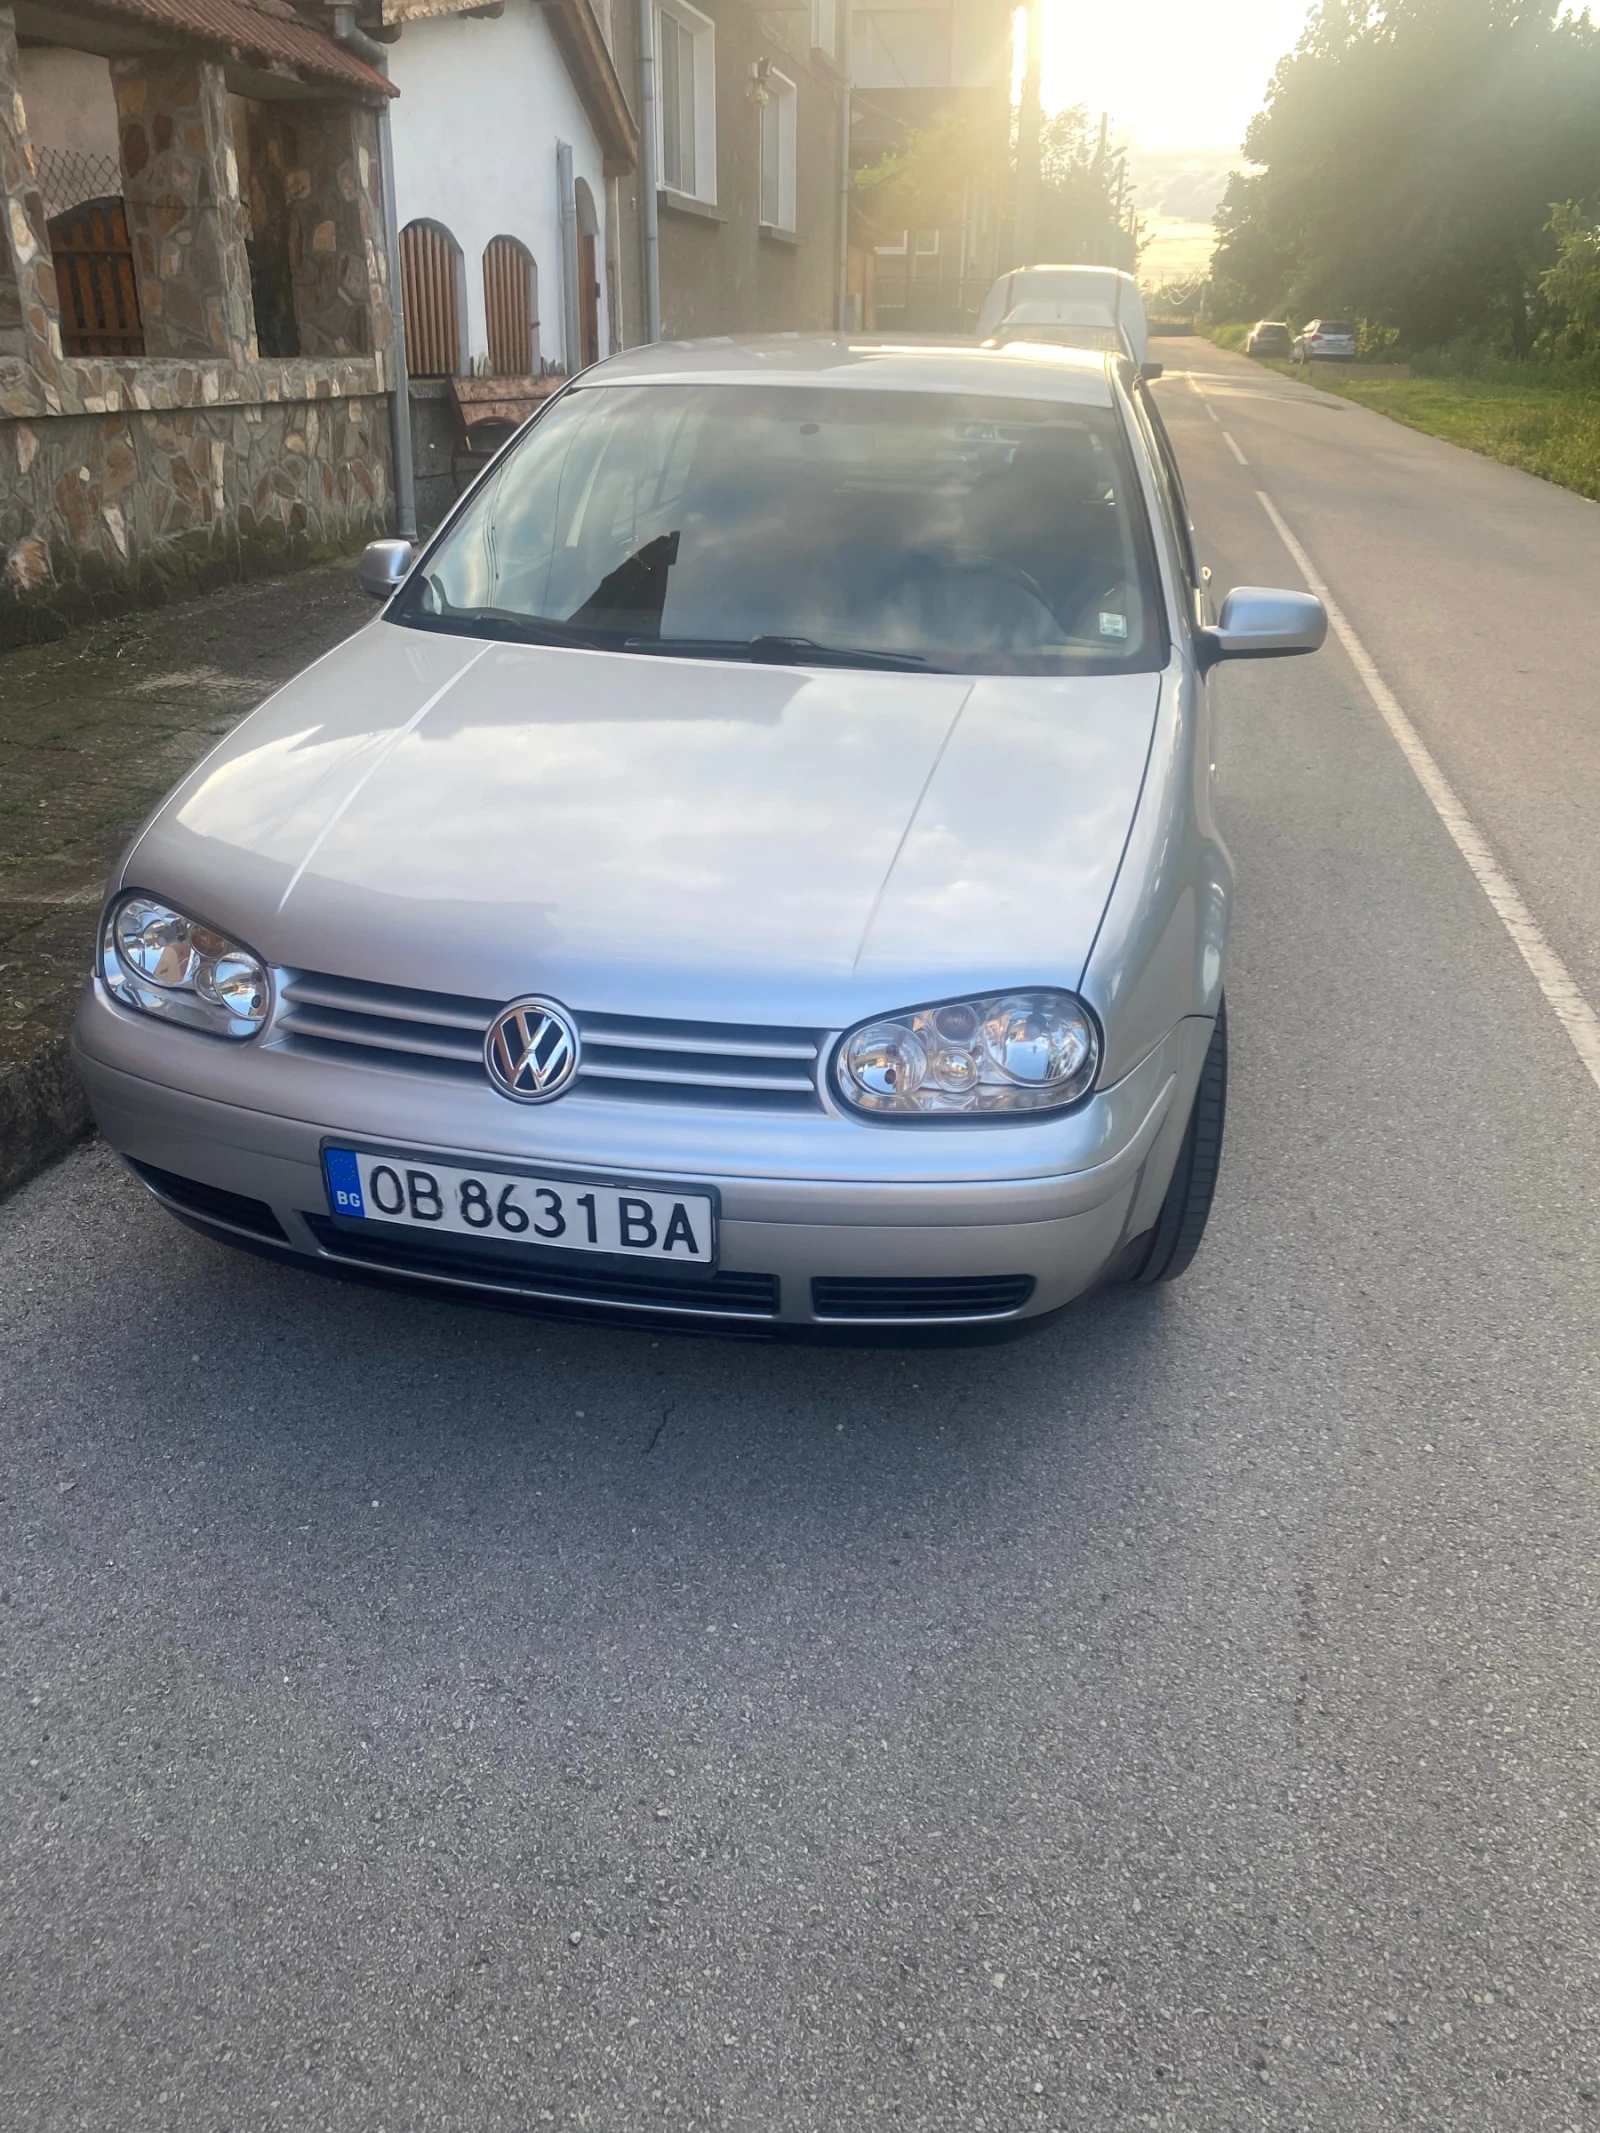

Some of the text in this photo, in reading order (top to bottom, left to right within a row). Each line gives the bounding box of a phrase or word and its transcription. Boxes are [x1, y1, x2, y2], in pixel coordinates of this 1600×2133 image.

[489, 1006, 569, 1092] VW
[336, 1190, 361, 1209] BG
[369, 1164, 700, 1254] OB 8631 BA
